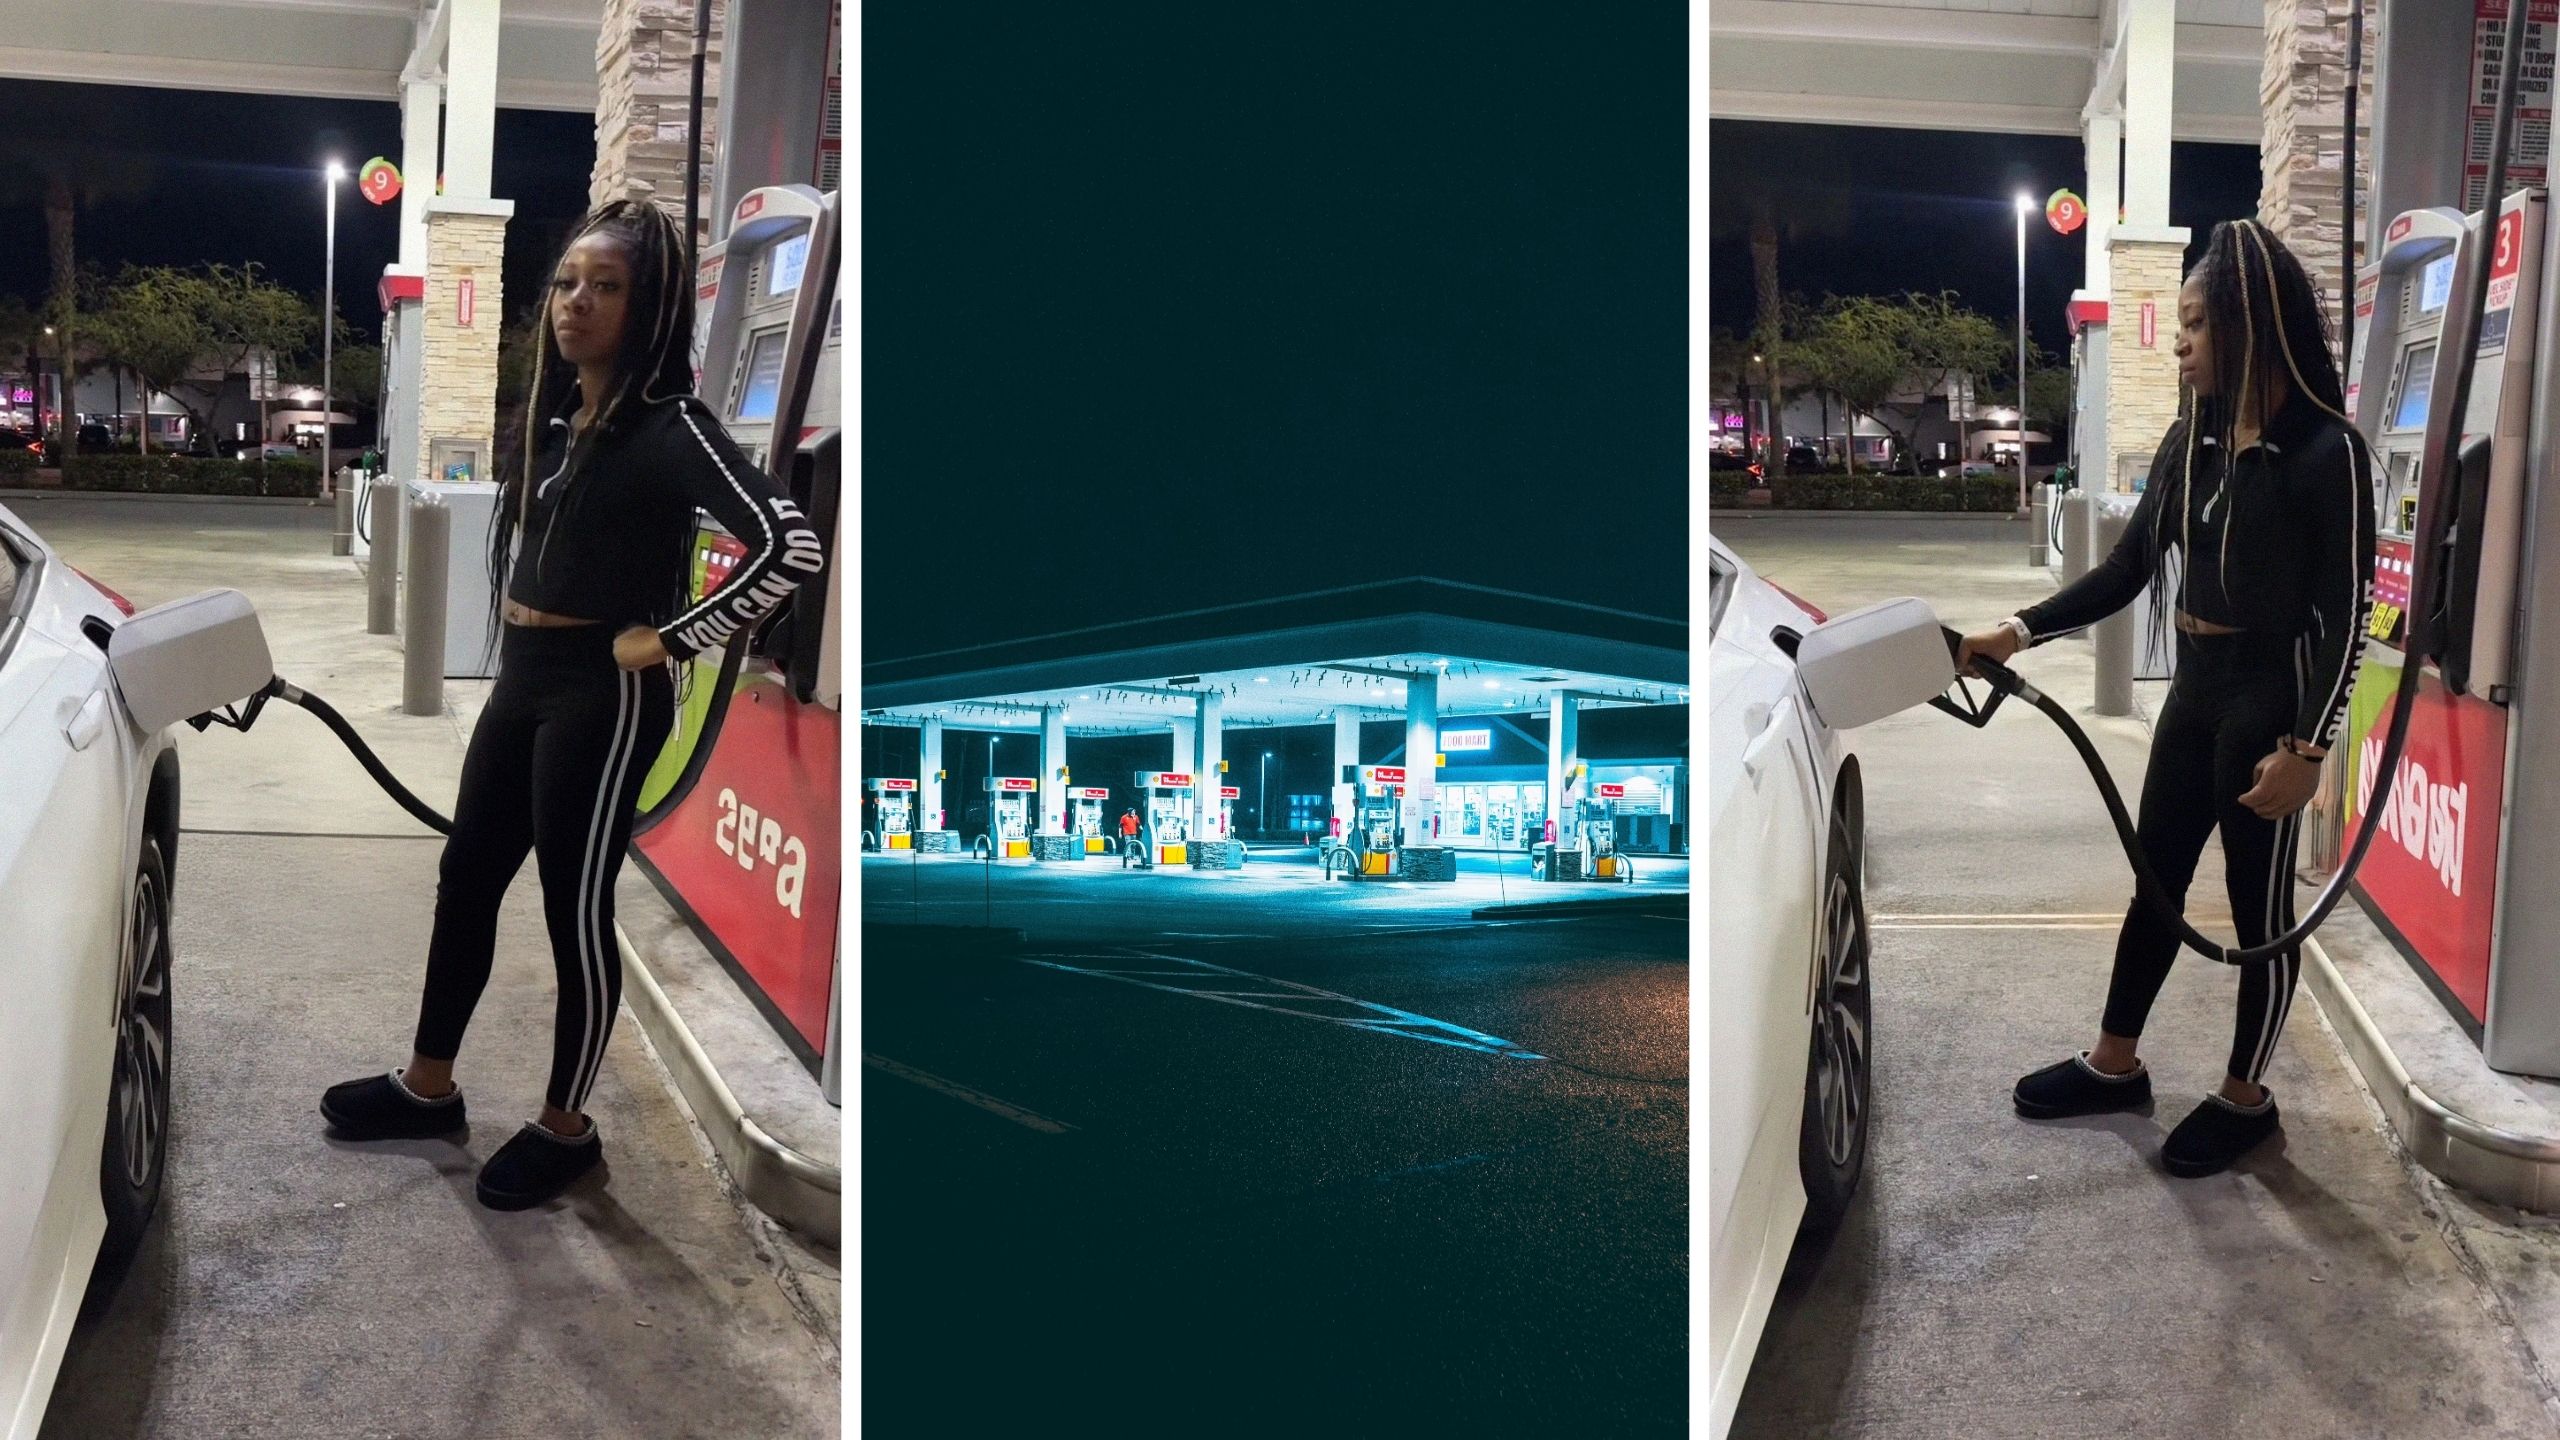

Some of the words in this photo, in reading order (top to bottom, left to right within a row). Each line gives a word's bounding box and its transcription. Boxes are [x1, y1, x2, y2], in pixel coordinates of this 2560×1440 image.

[2486, 20, 2499, 32] NO
[2530, 67, 2553, 79] GLASS
[374, 171, 388, 190] 9
[2060, 202, 2073, 220] 9
[2497, 219, 2512, 268] 3
[677, 611, 742, 652] YOU
[731, 570, 801, 619] CAN
[781, 529, 824, 574] DO
